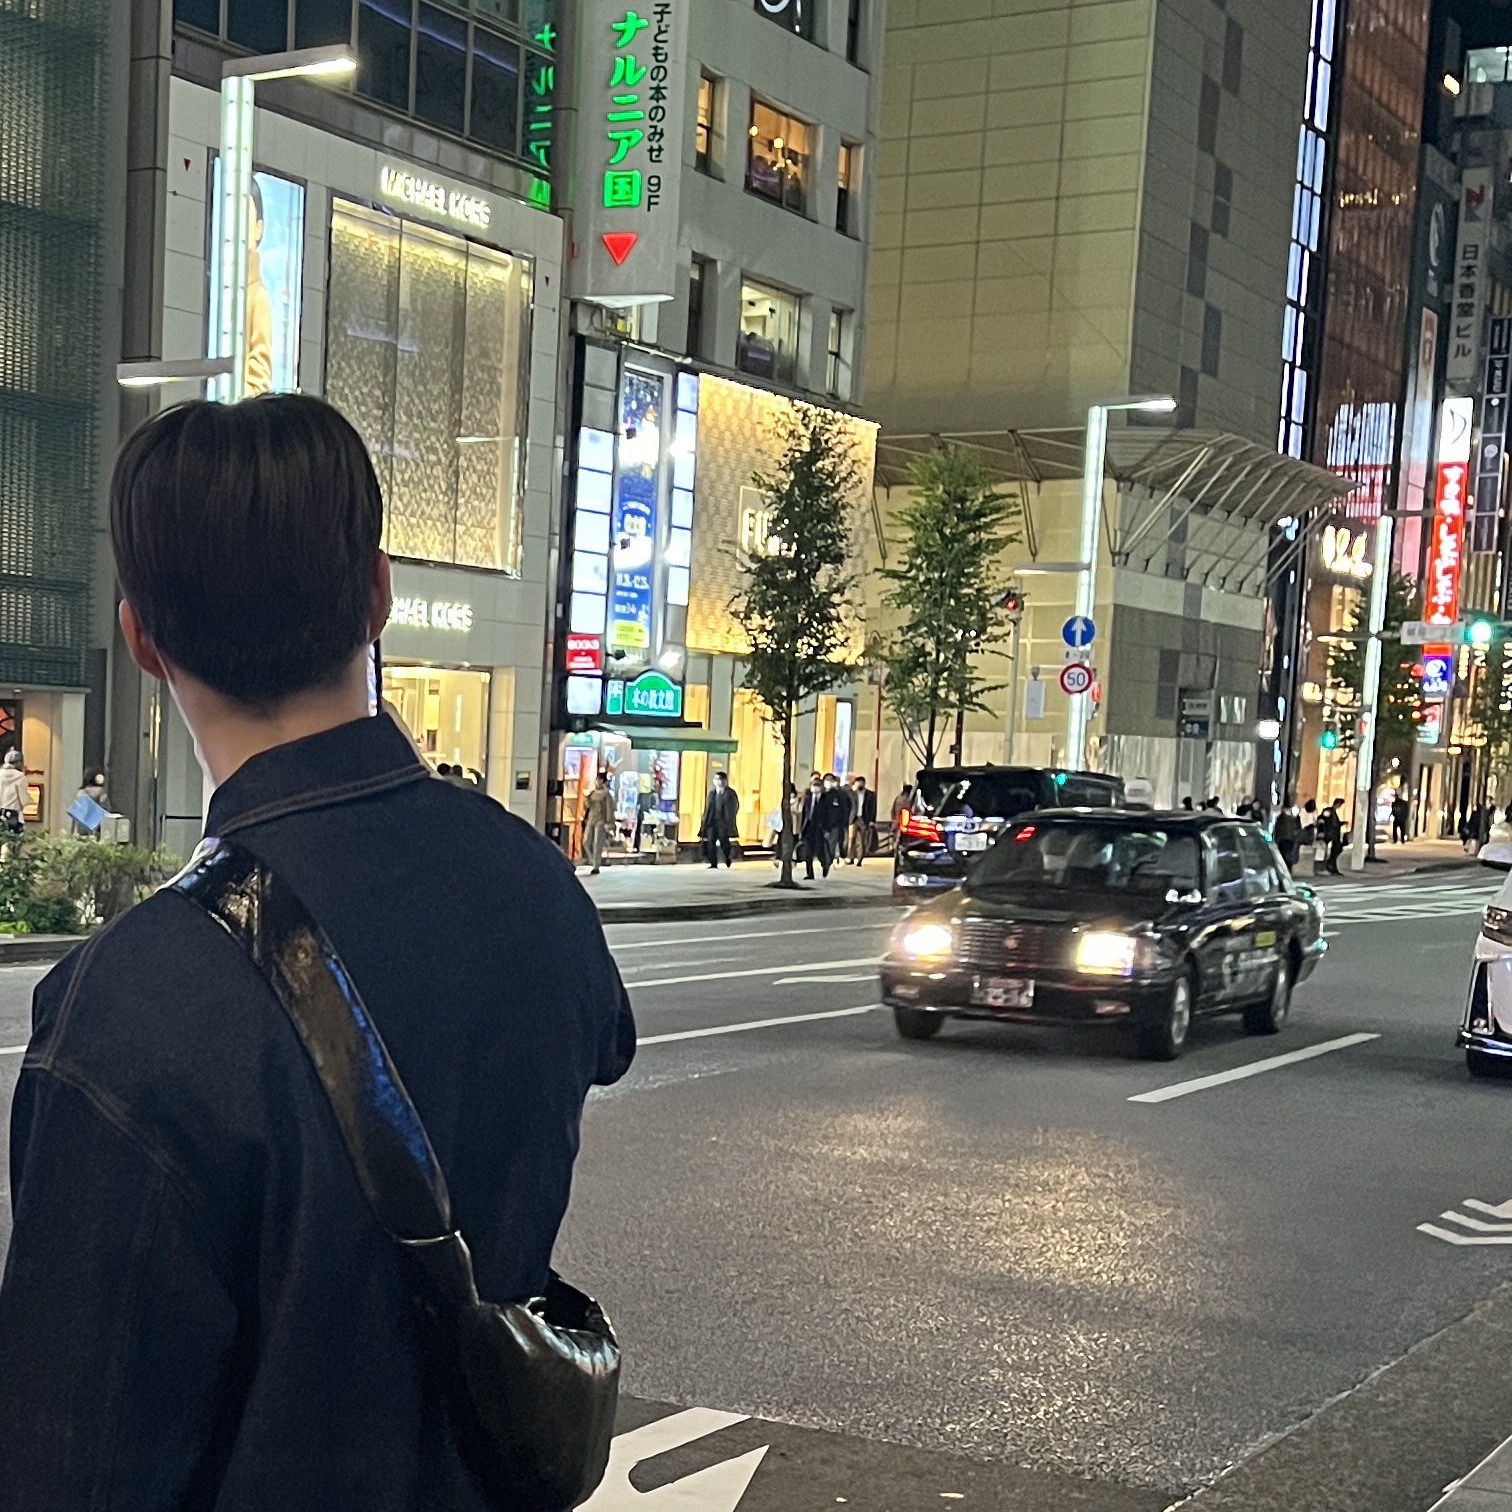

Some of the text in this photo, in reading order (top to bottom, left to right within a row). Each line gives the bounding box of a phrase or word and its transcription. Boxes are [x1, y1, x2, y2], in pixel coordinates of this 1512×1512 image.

[603, 10, 649, 209] ナルニア国
[646, 2, 672, 212] 子どもの本のみせ 9F
[381, 166, 492, 229] MICHAEL KORS
[431, 601, 473, 633] KORS
[1066, 672, 1086, 687] 50
